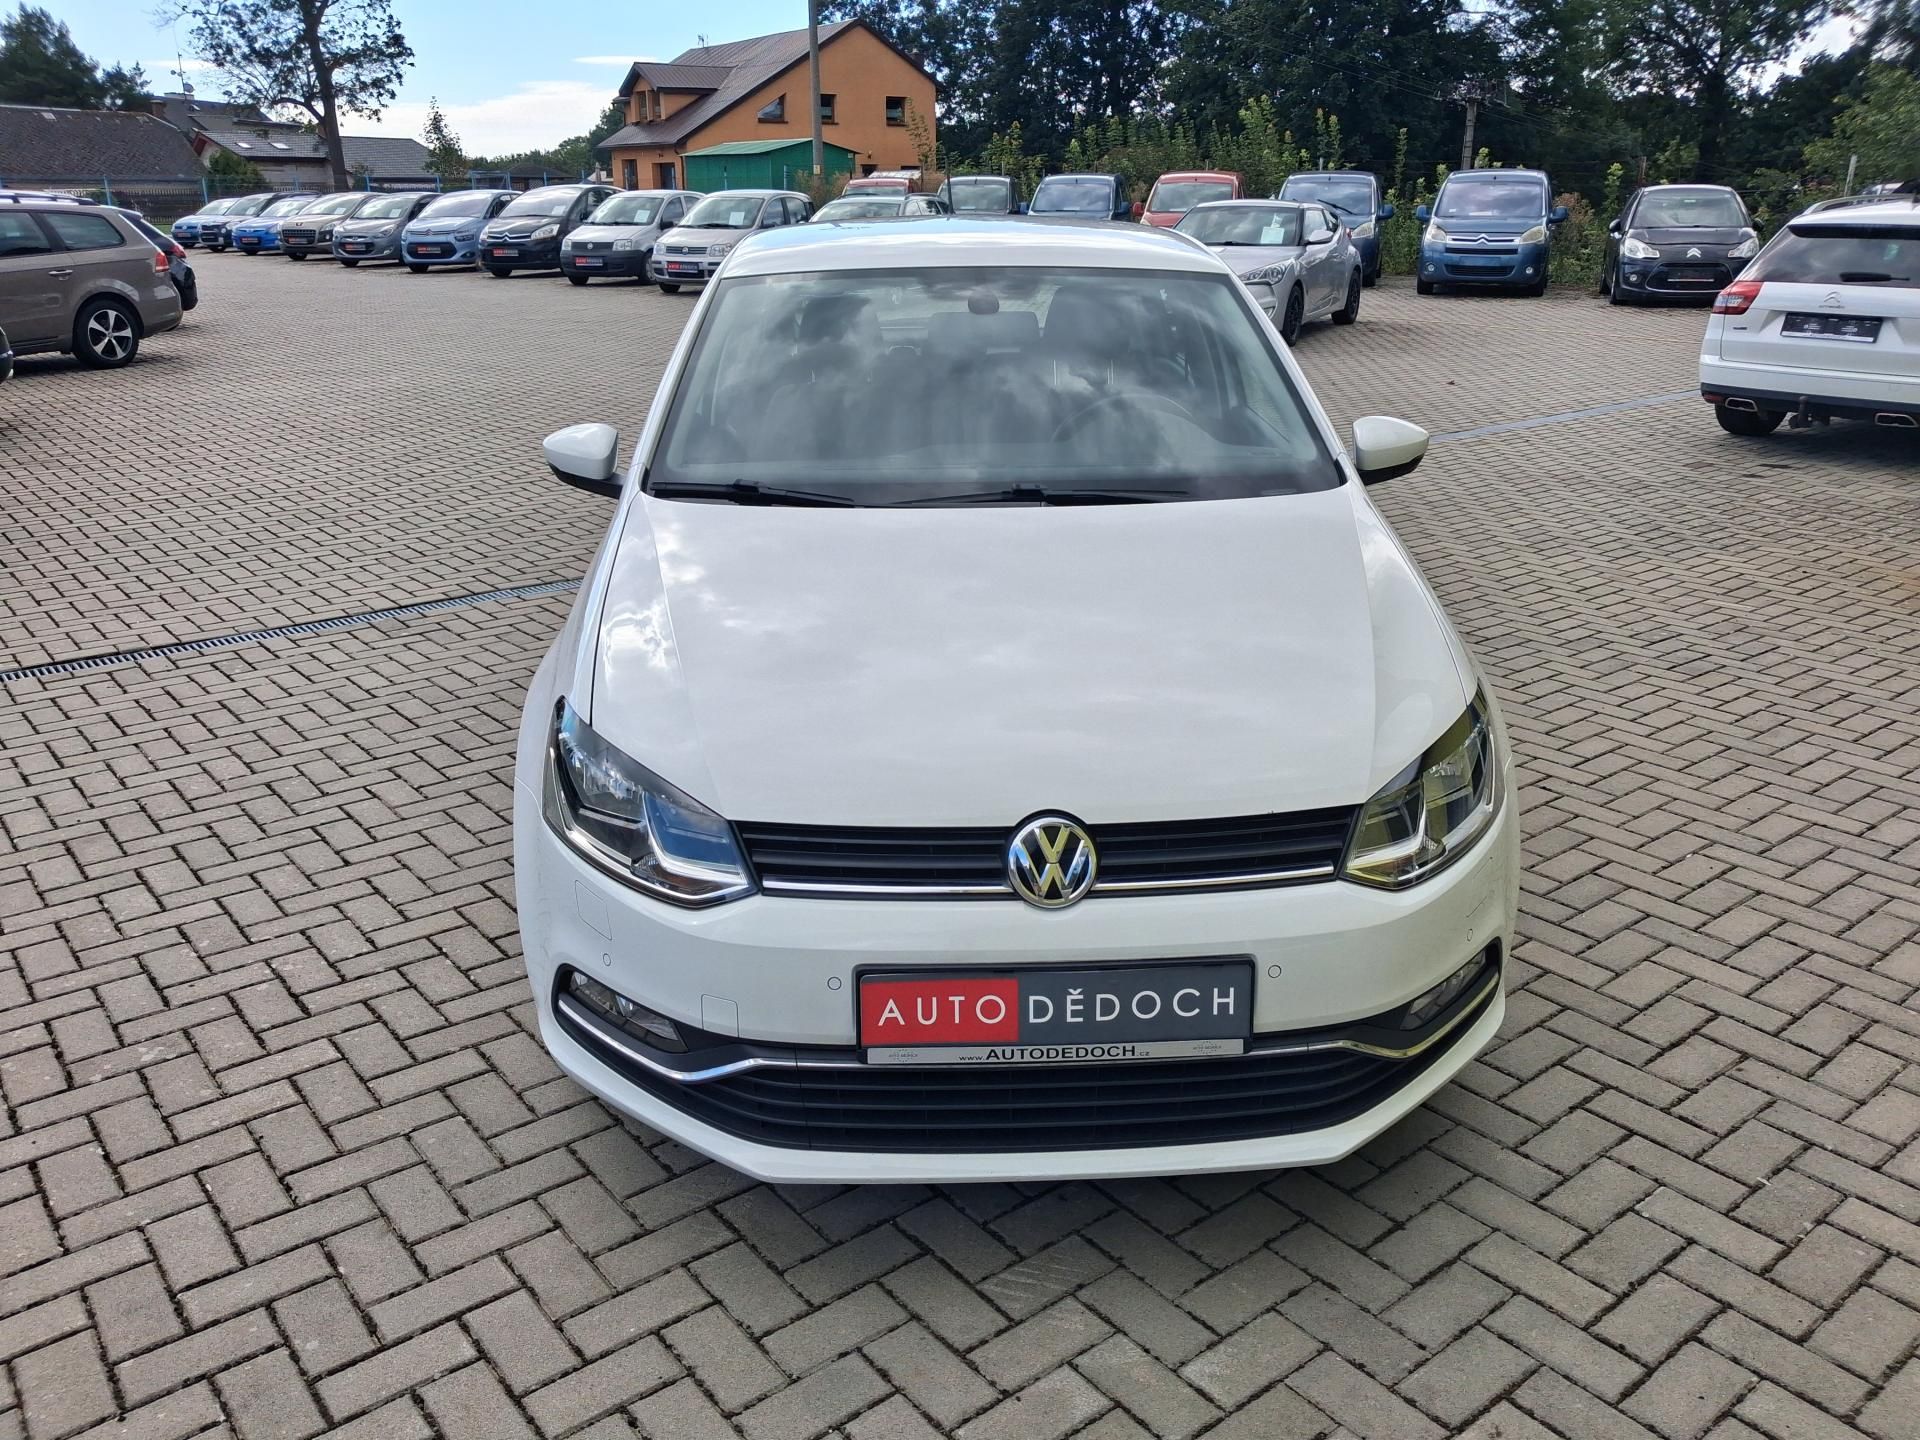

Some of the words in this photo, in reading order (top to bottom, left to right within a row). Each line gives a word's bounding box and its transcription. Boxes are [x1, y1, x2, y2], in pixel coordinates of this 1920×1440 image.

[877, 994, 1007, 1026] AUTO
[1029, 987, 1235, 1024] DĚDOCH
[958, 1045, 1150, 1062] www.AUTODEDOCH.cz
